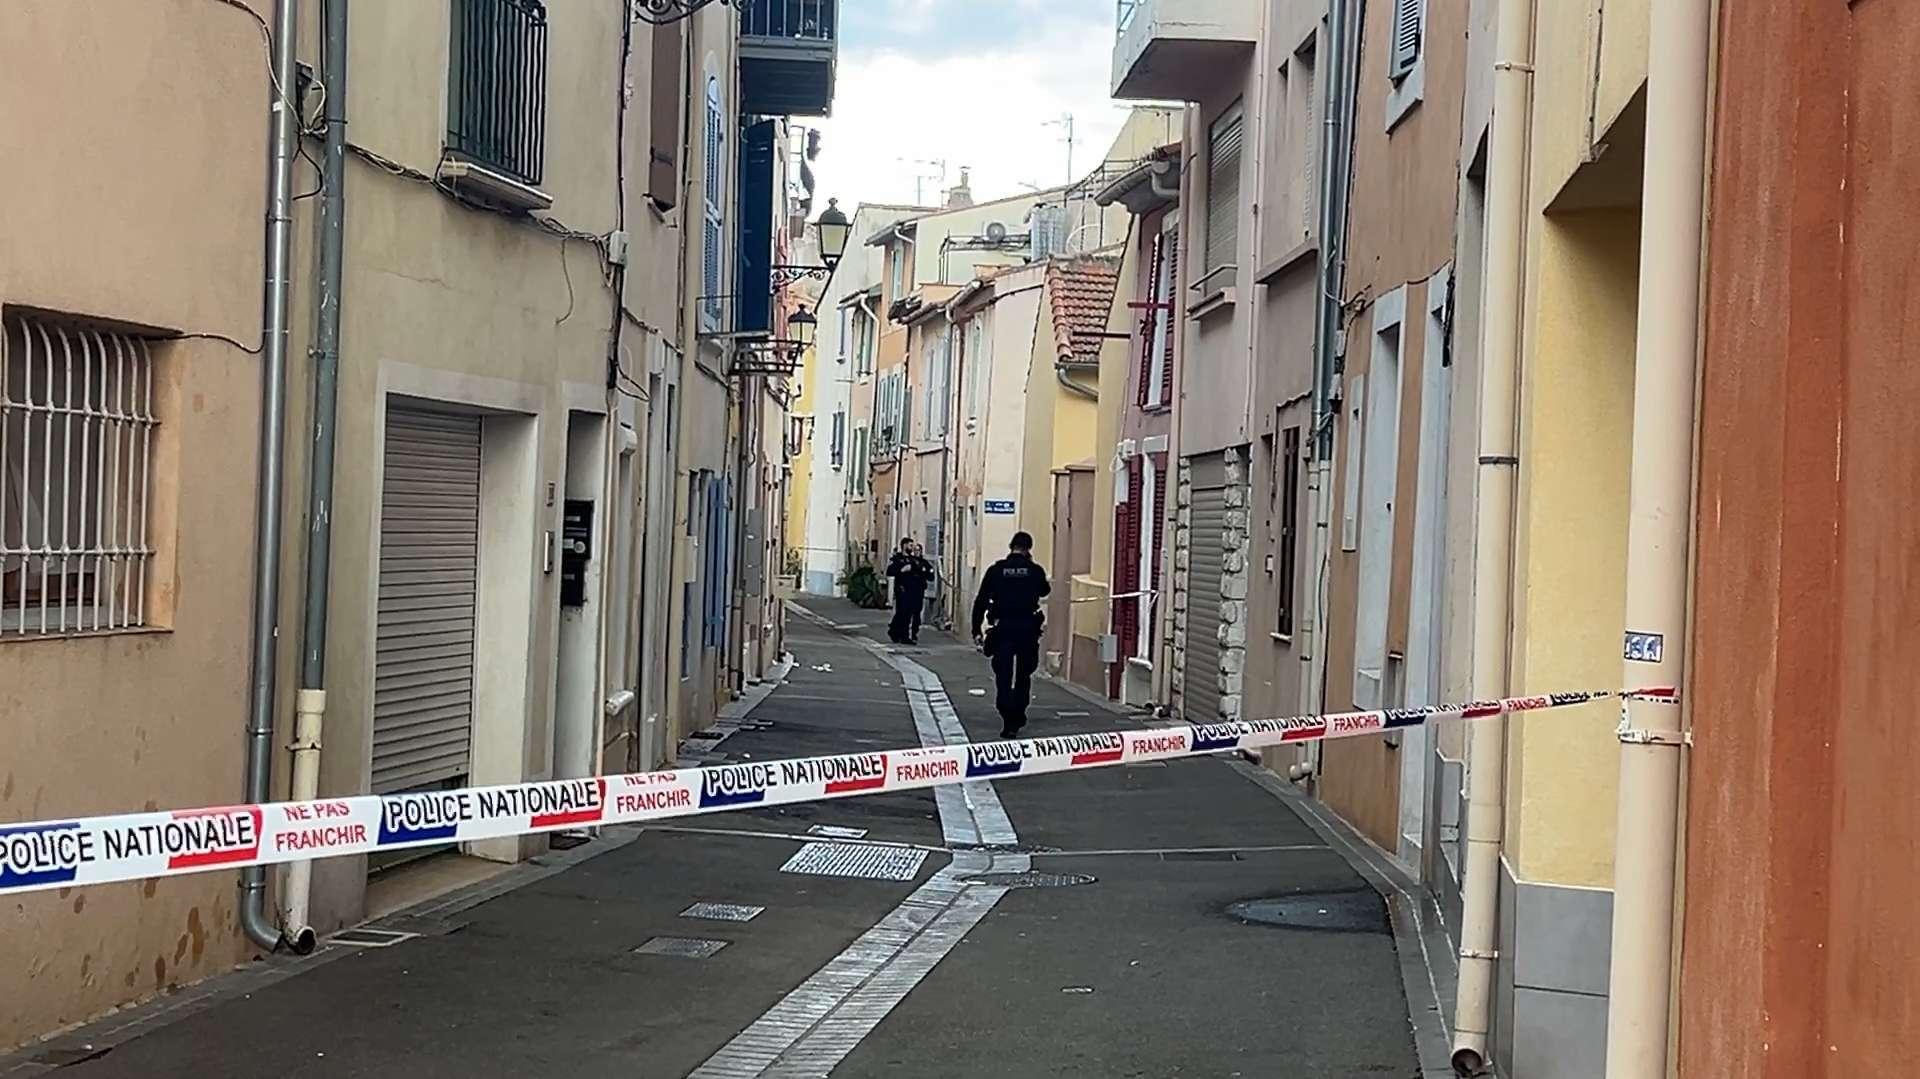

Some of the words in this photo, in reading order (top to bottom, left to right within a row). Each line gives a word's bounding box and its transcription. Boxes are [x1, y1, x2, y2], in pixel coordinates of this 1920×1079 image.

[1333, 714, 1380, 731] FRANCHIR
[974, 742, 1032, 765] POLICE
[1033, 734, 1121, 758] NATIONALE
[1132, 735, 1186, 754] FRANCHIR
[708, 763, 777, 792] POLICE
[781, 755, 882, 785] NATIONALE
[896, 760, 959, 781] FRANCHIR
[284, 804, 310, 821] NE
[313, 801, 350, 819] PAS
[389, 795, 472, 828] POLICE
[477, 781, 600, 819] NATIONALE
[617, 789, 691, 813] FRANCHIR
[103, 816, 253, 860] NATIONALE
[275, 824, 367, 851] FRANCHIR
